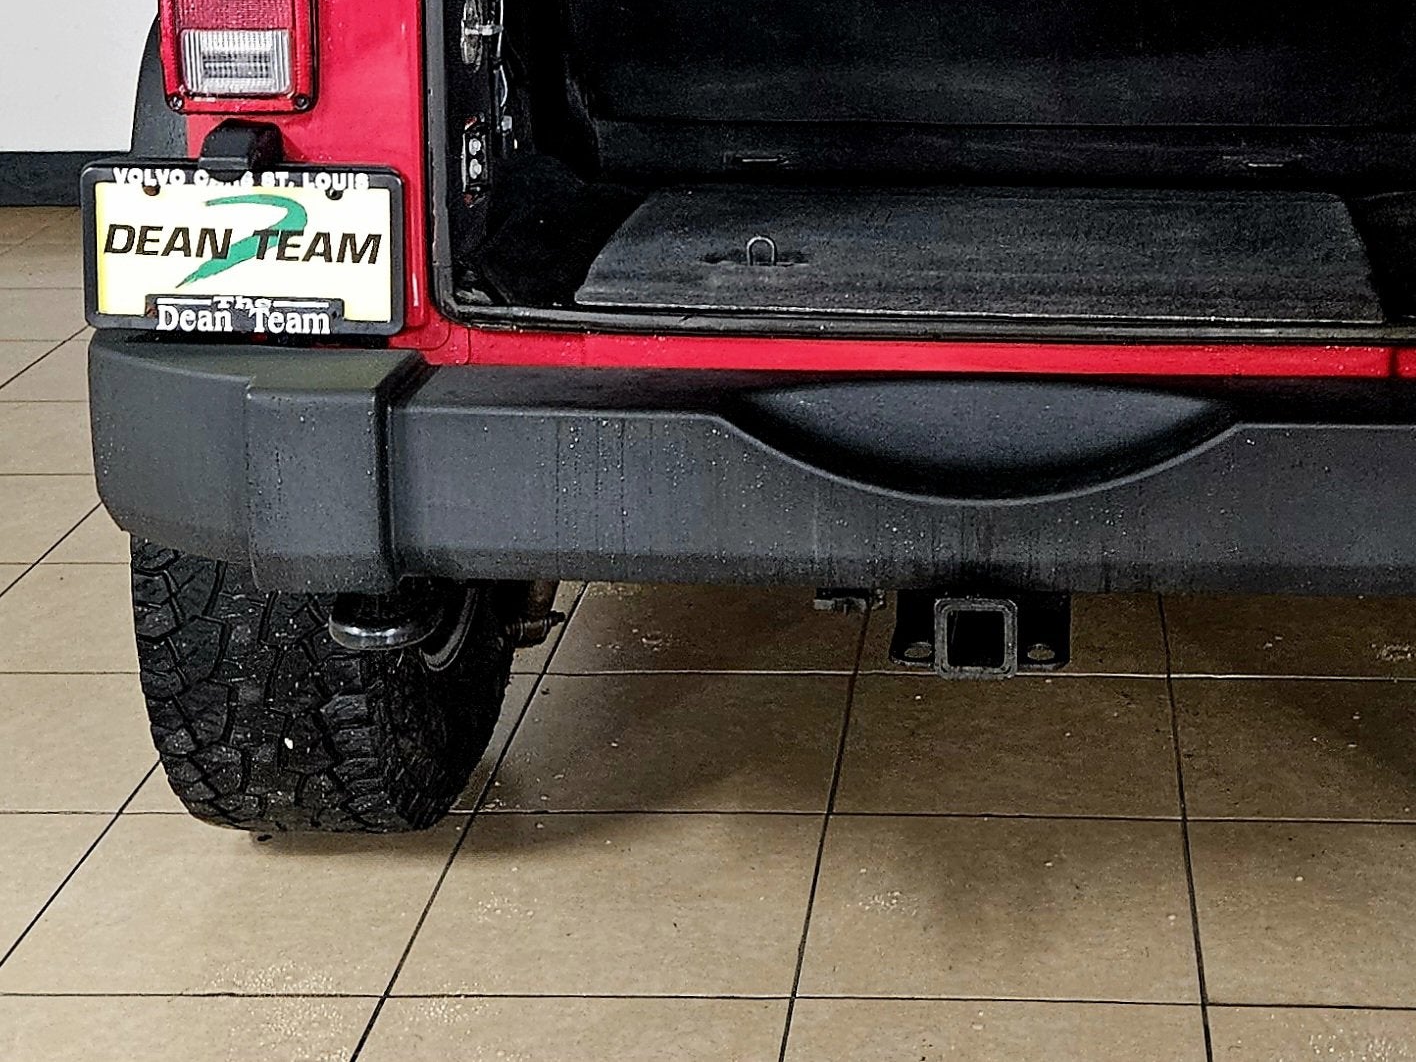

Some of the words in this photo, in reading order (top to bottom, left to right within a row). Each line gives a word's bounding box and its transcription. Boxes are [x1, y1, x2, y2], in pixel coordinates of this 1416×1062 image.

[113, 167, 186, 188] VOLVO
[194, 169, 255, 188] CS
[302, 172, 369, 192] LOUIS
[103, 223, 233, 260] DEAN
[251, 229, 383, 265] TEAM
[213, 295, 273, 310] The
[156, 304, 233, 333] Dean
[249, 306, 331, 335] Team
